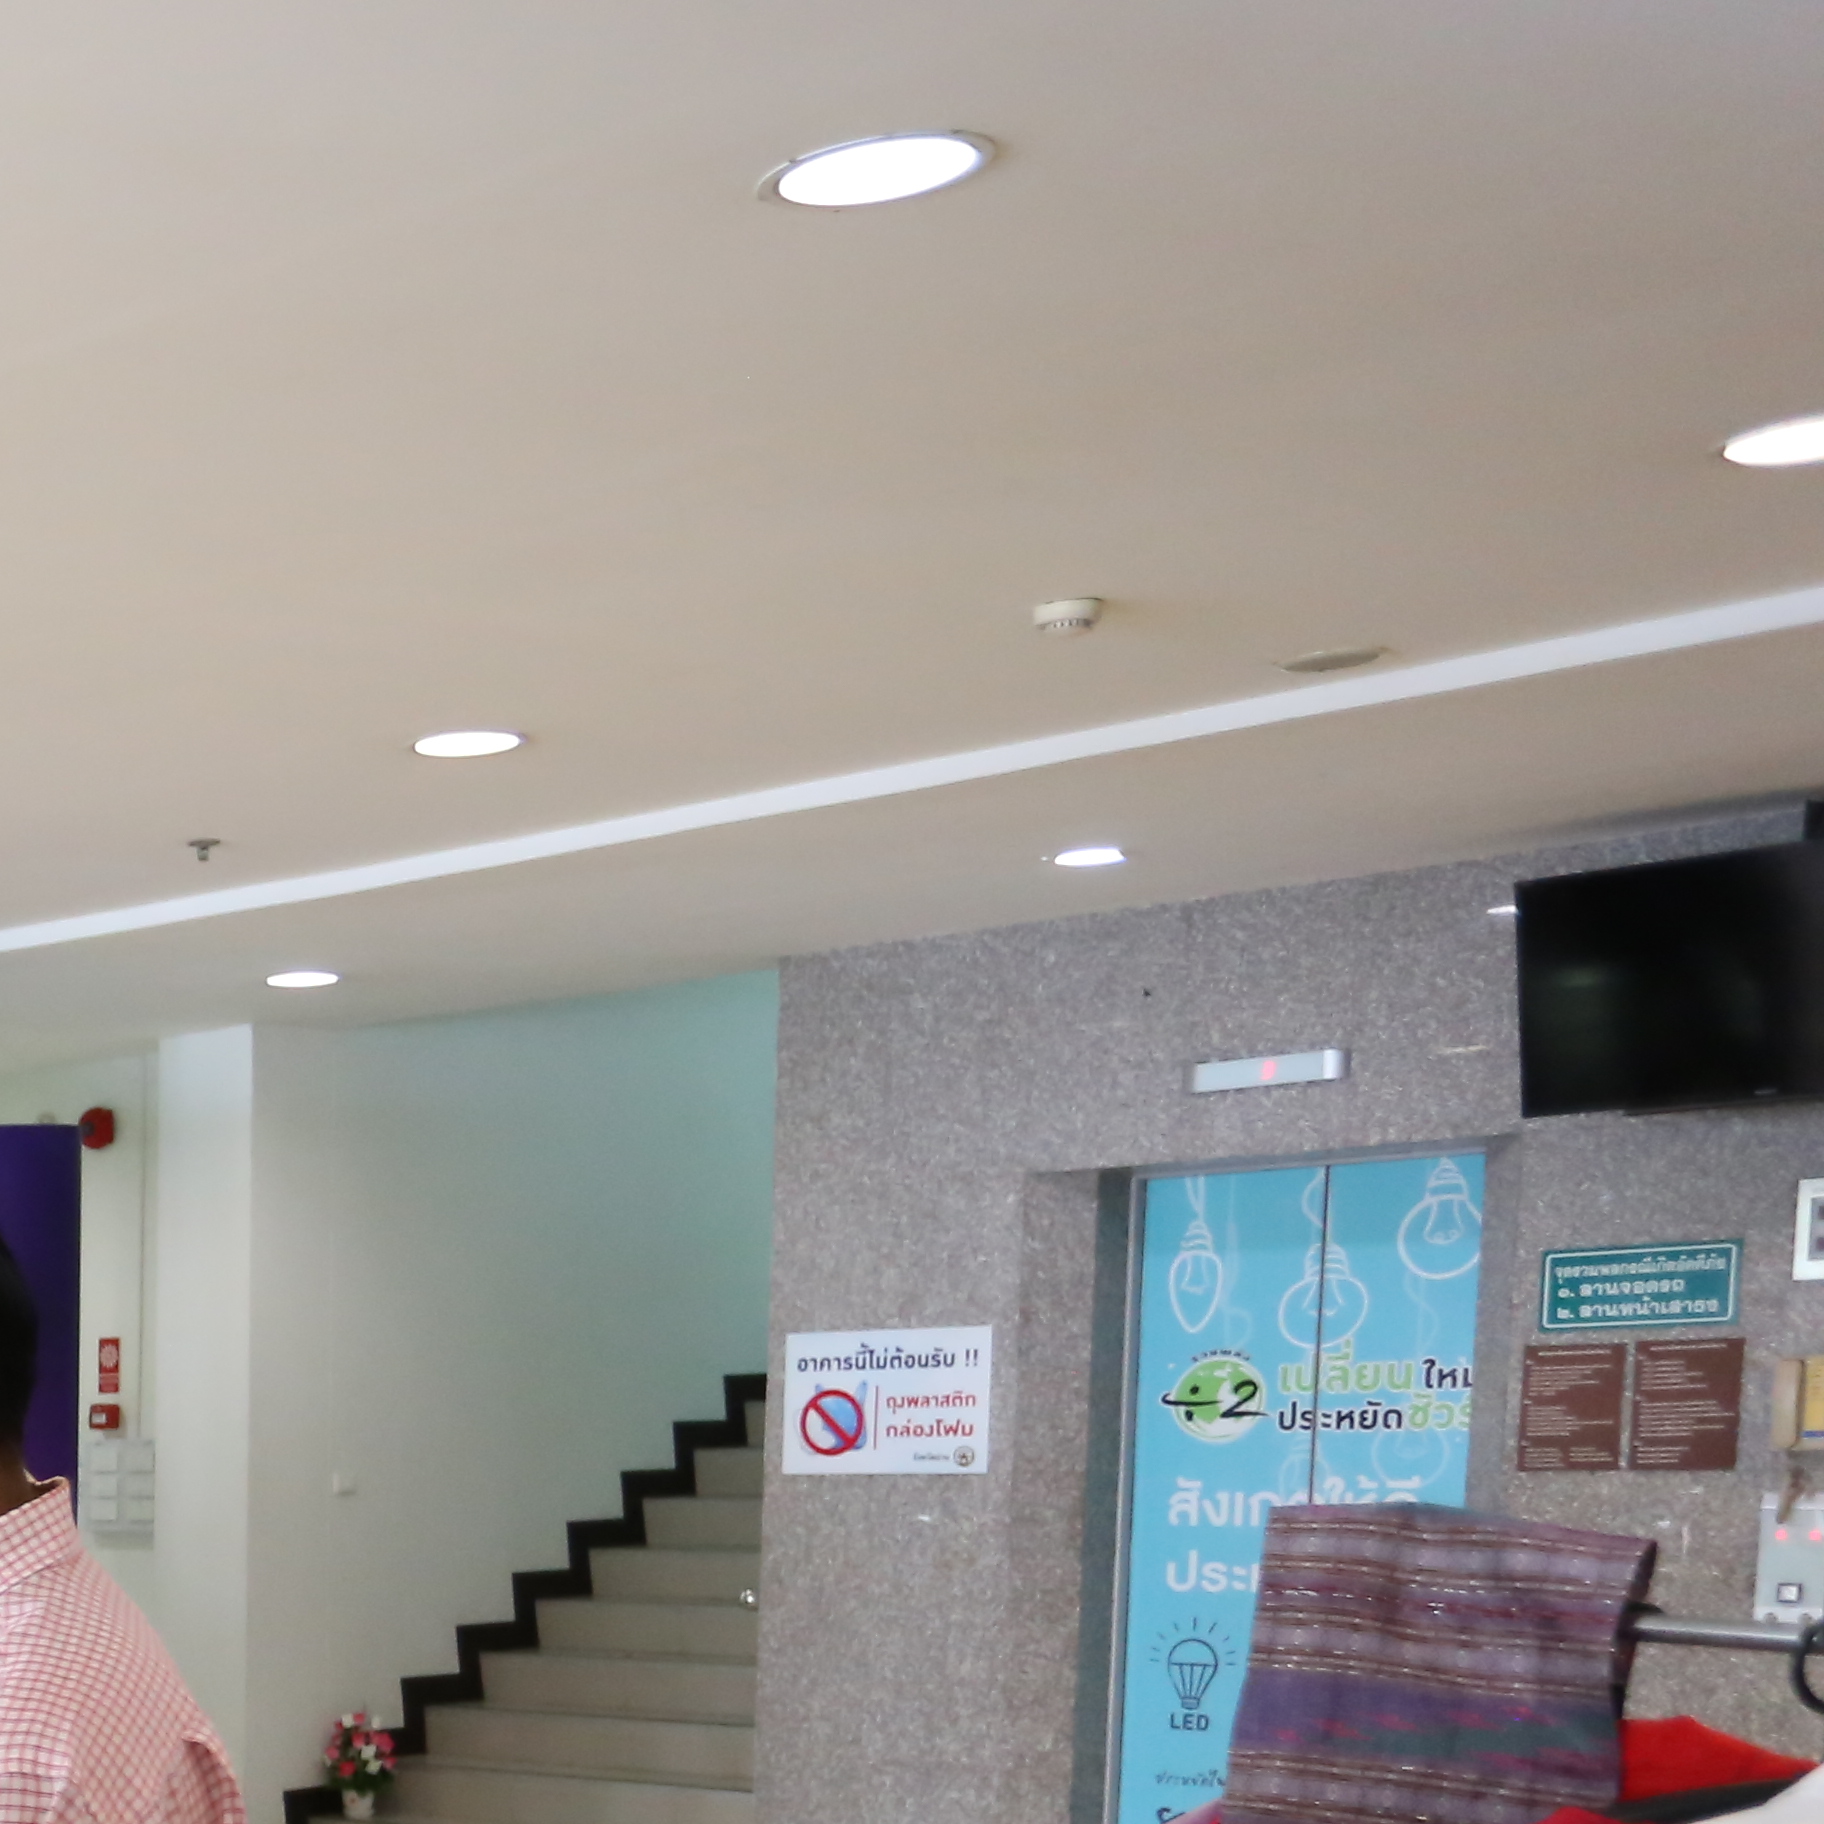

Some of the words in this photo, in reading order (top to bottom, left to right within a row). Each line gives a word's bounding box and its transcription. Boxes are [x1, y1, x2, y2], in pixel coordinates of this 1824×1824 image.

[1579, 1278, 1685, 1297] ลานจอดรถ
[1579, 1296, 1719, 1318] ลานหน้าเสาธง
[797, 1343, 956, 1372] อาคารนี้ไม่ต้อนรับ
[886, 1390, 976, 1415] ถุงพลาสติก
[886, 1418, 974, 1437] กล่องโฟม
[1165, 1549, 1261, 1592] ประ
[1170, 1713, 1210, 1731] LED
